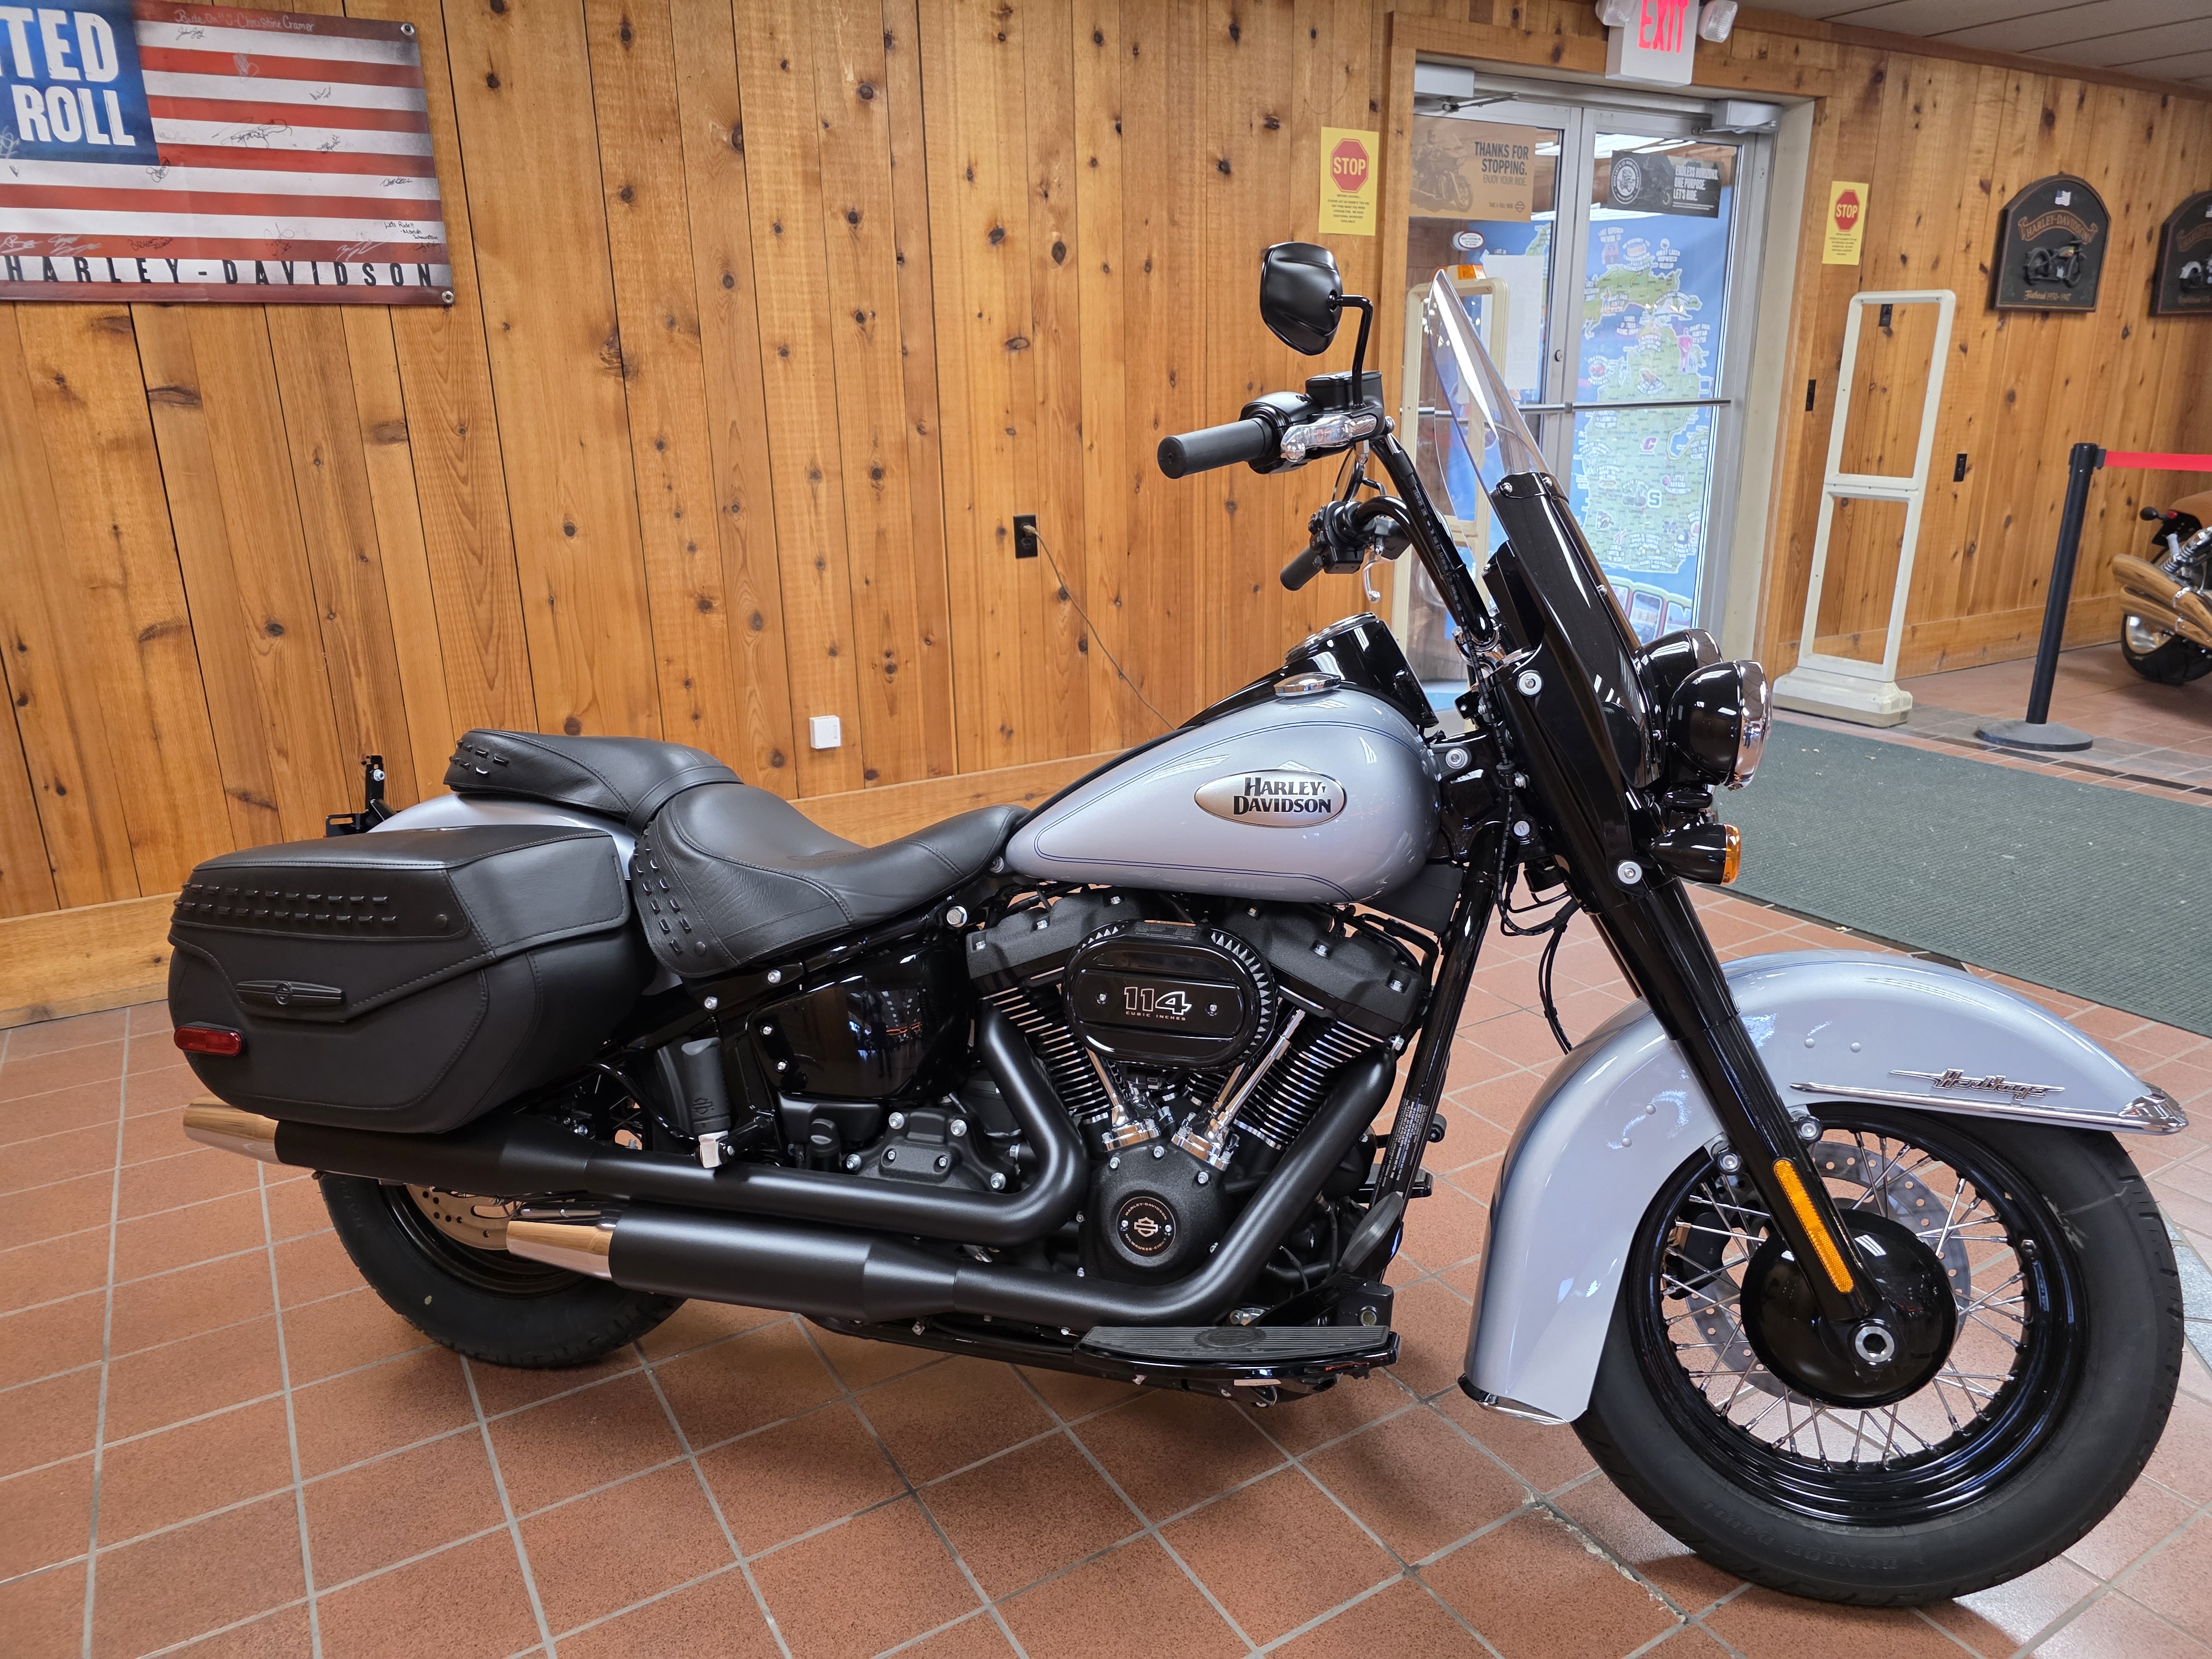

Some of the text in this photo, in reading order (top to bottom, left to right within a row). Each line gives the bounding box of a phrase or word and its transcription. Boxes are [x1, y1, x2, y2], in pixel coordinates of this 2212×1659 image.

[1638, 0, 1688, 53] EXIT
[0, 6, 118, 82] TED
[11, 85, 135, 146] ROLL
[1474, 141, 1528, 160] THANKS FOR
[1333, 156, 1366, 175] STOP
[1481, 158, 1527, 175] STOPPING.
[1675, 166, 1695, 178] ENDLESS
[1500, 175, 1514, 185] YOUR
[1674, 177, 1684, 187] ONE
[1673, 188, 1685, 200] LET'S
[1835, 203, 1858, 220] STOP
[2026, 215, 2090, 242] HARLEY-DAVIDSON
[1650, 492, 1660, 505] S
[1233, 796, 1331, 815] DAVIDSON
[1124, 987, 1192, 1015] 114
[1936, 1068, 2047, 1100] Heritage
[1125, 1202, 1167, 1220] HARLEY-DAVIDSON
[1784, 1543, 1900, 1570] DUNLOP
